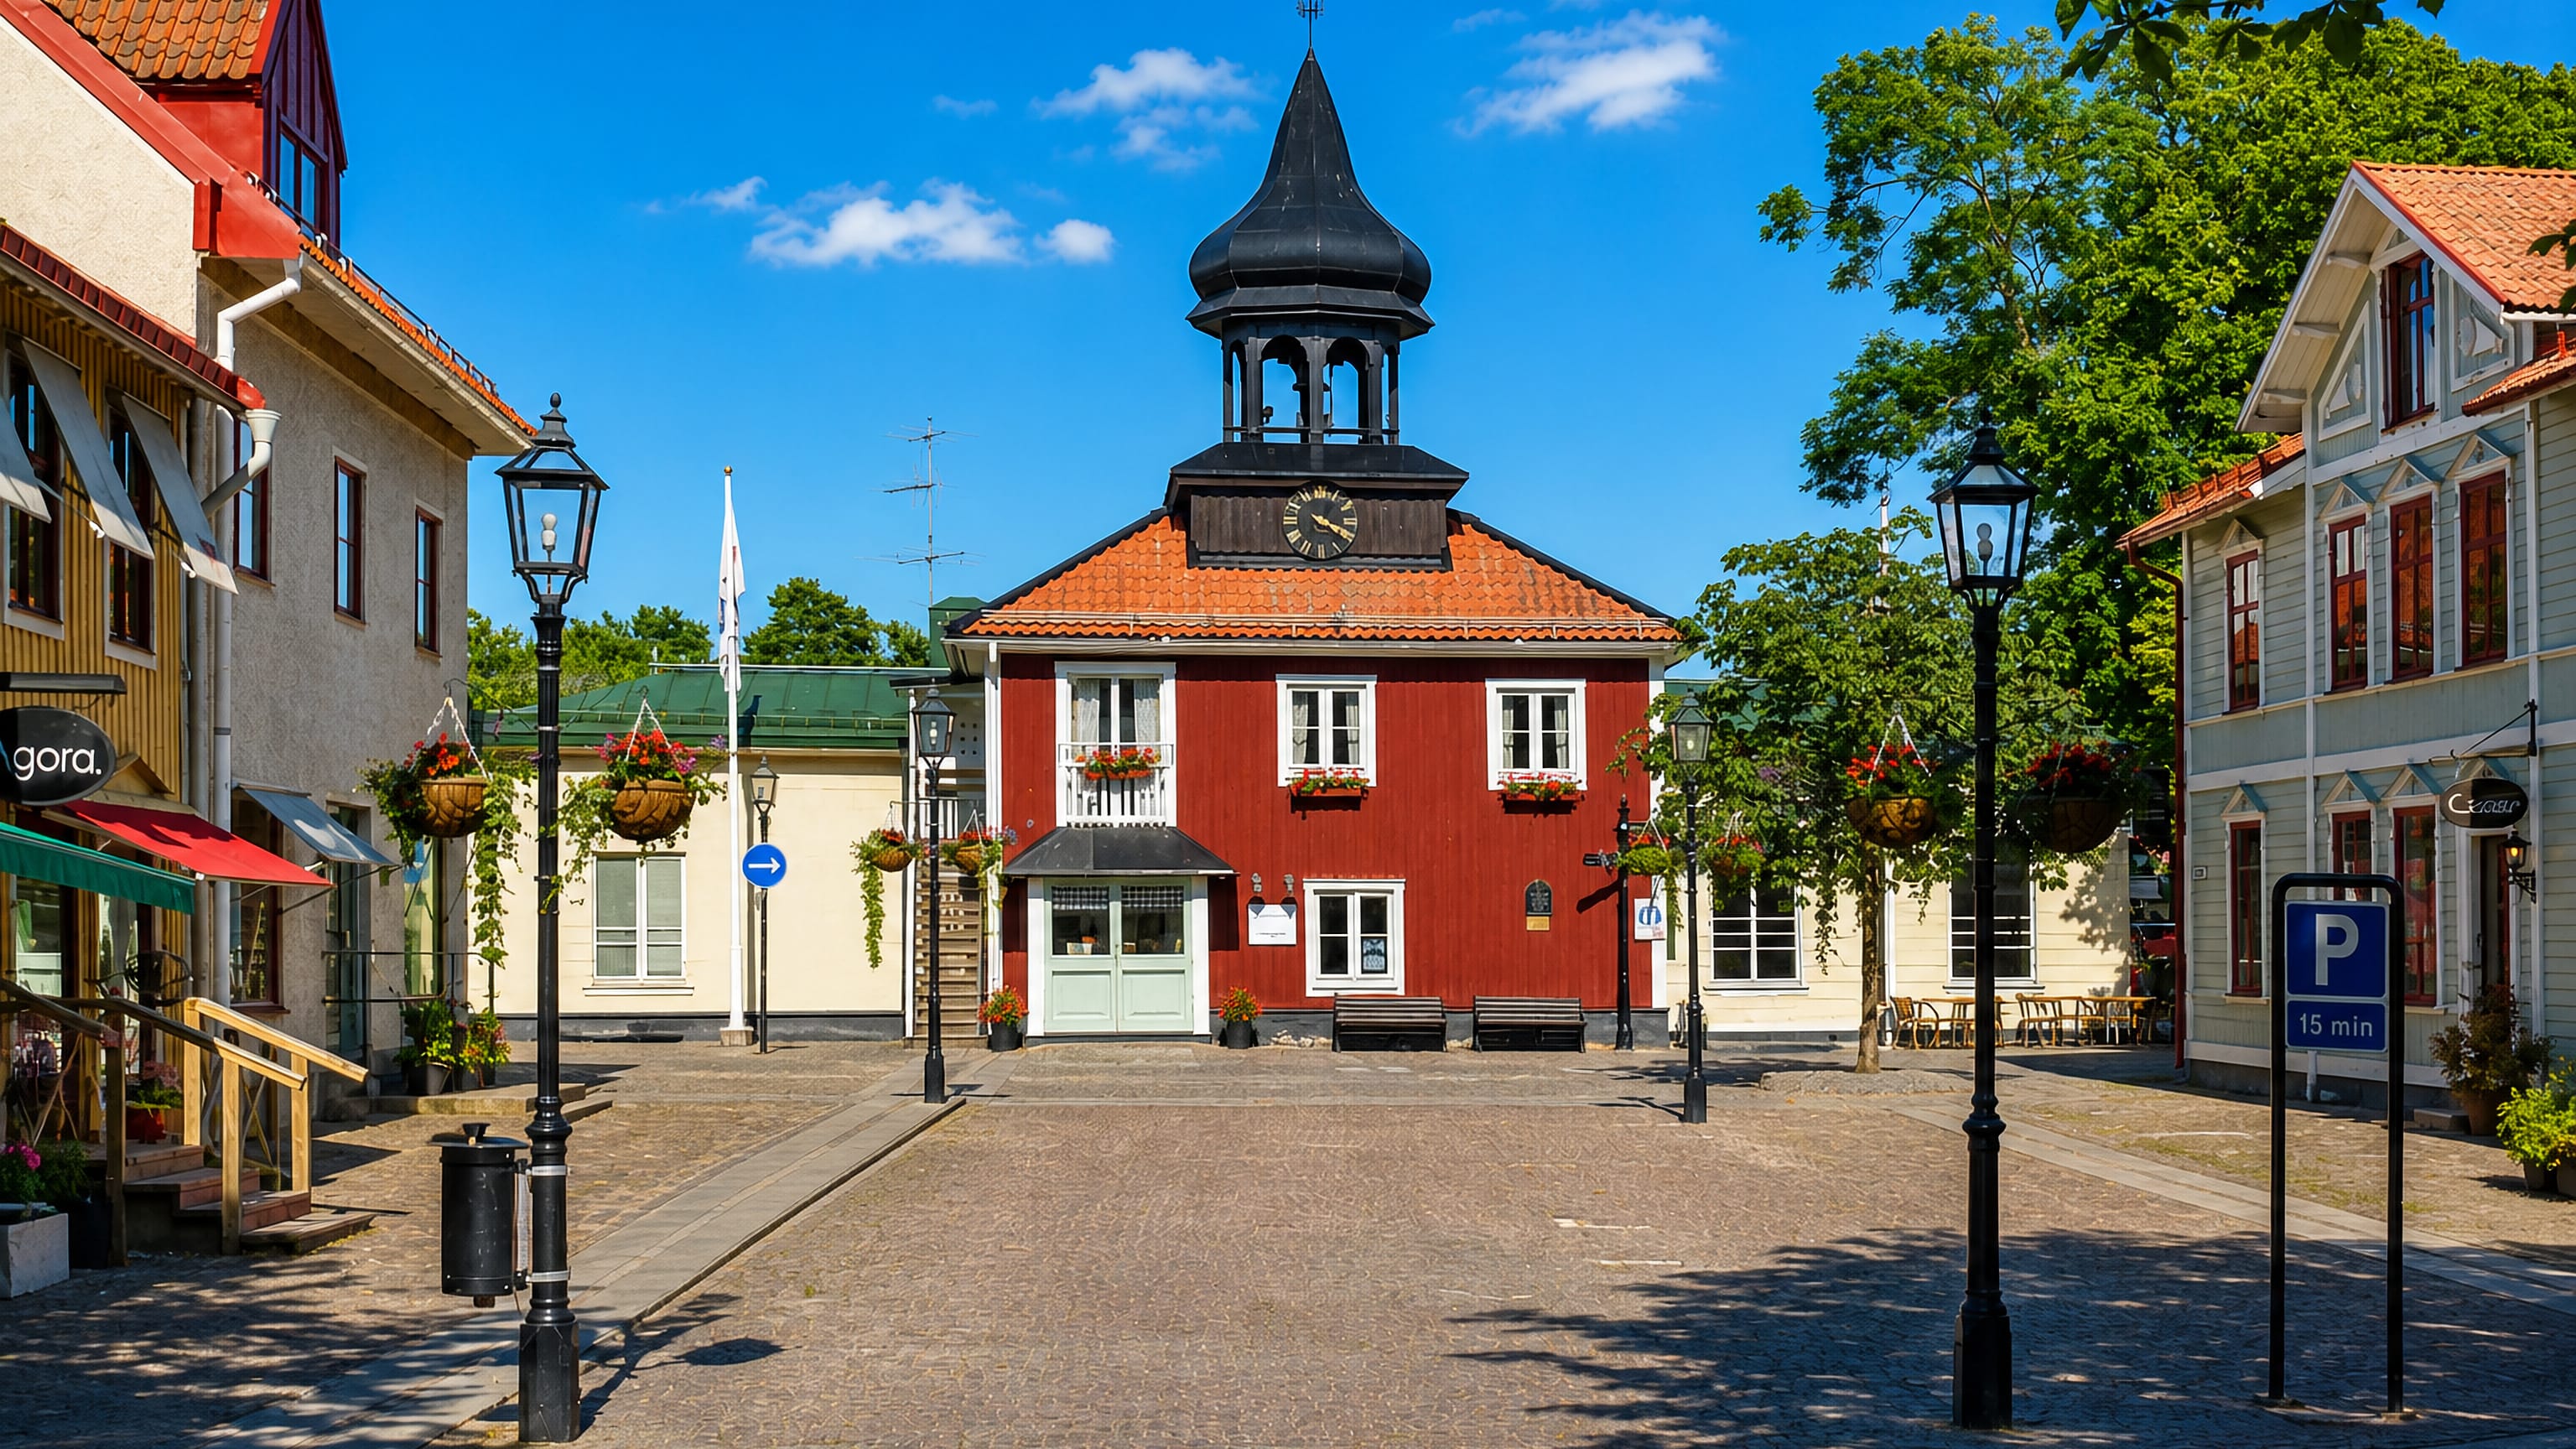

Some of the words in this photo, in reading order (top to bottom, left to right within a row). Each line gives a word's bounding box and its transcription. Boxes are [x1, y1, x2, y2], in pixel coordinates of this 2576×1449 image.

[2315, 913, 2360, 986] P
[2299, 1012, 2322, 1035] 15
[2331, 1015, 2373, 1037] min
